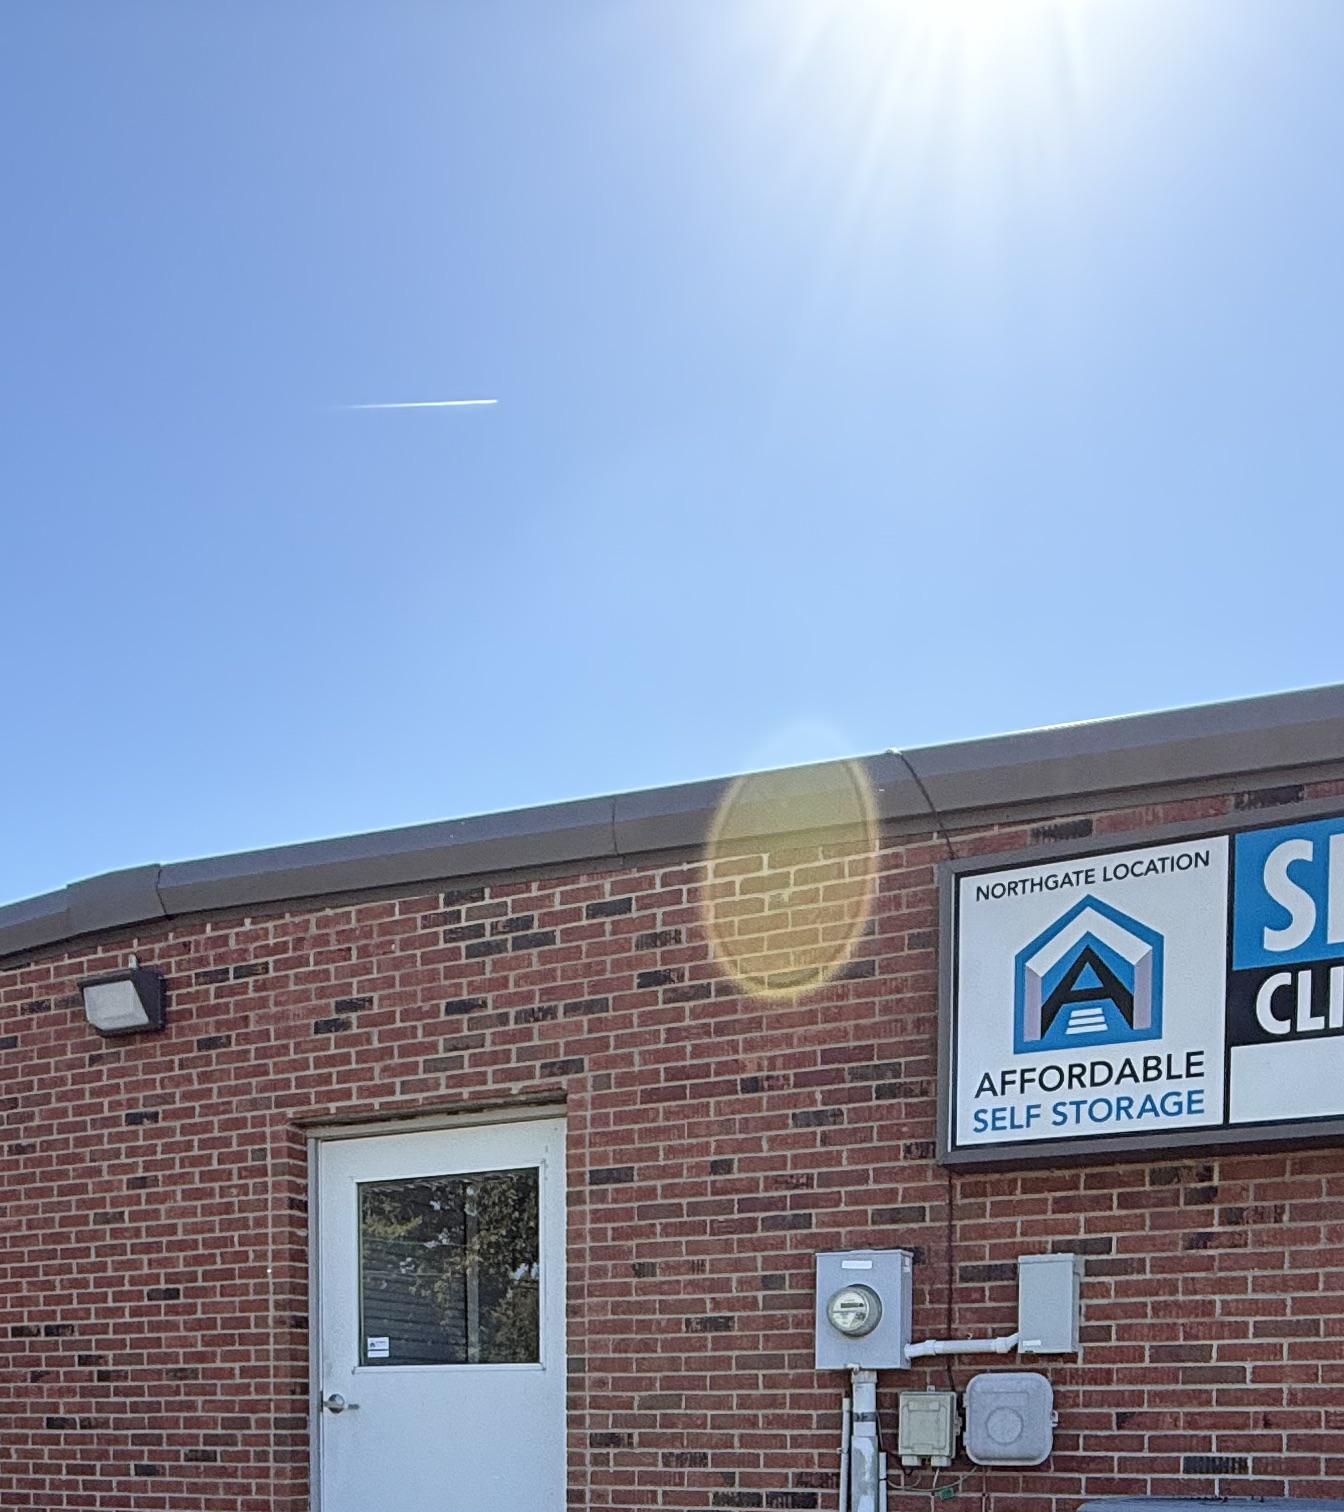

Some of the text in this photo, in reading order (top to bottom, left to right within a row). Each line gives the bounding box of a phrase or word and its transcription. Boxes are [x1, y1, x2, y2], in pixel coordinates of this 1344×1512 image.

[976, 850, 1210, 902] NORTHGATE LOCATION
[974, 1050, 1205, 1098] AFFORDABLE
[973, 1089, 1205, 1133] SELF STORAGE
